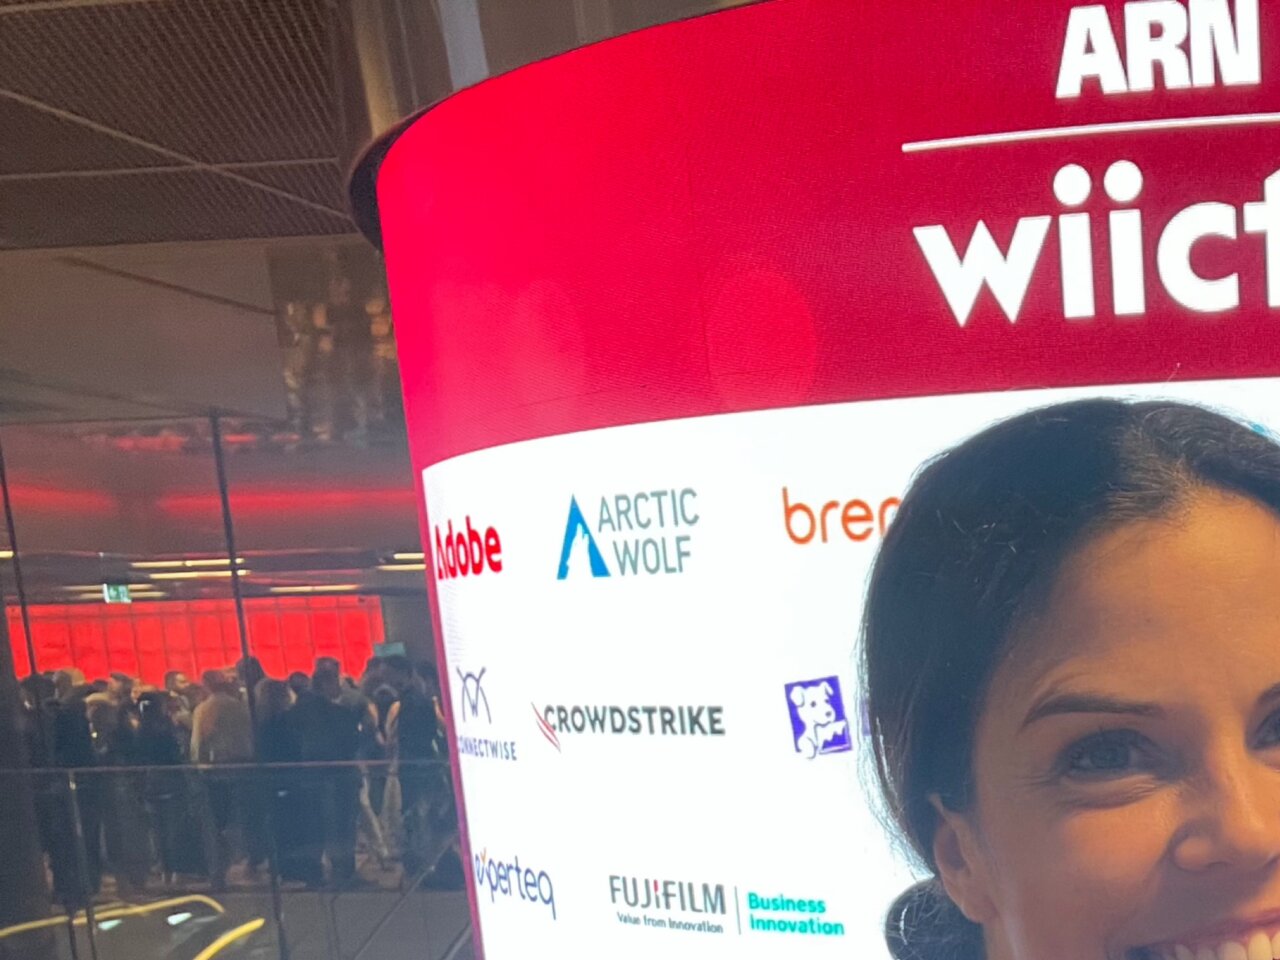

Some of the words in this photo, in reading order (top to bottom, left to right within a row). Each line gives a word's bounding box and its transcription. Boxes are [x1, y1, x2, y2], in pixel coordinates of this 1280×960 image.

[1055, 0, 1261, 99] ARN
[598, 487, 700, 532] ARCTIC
[434, 515, 503, 580] Adobe
[613, 535, 691, 576] WOLF
[543, 704, 726, 736] CROWDSTRIKE
[475, 847, 556, 920] experteq
[609, 874, 727, 915] FUJIFILM
[747, 891, 827, 914] Business
[617, 911, 641, 926] Value
[643, 914, 667, 929] from
[668, 917, 724, 934] Innovation
[749, 913, 845, 936] Innovation
